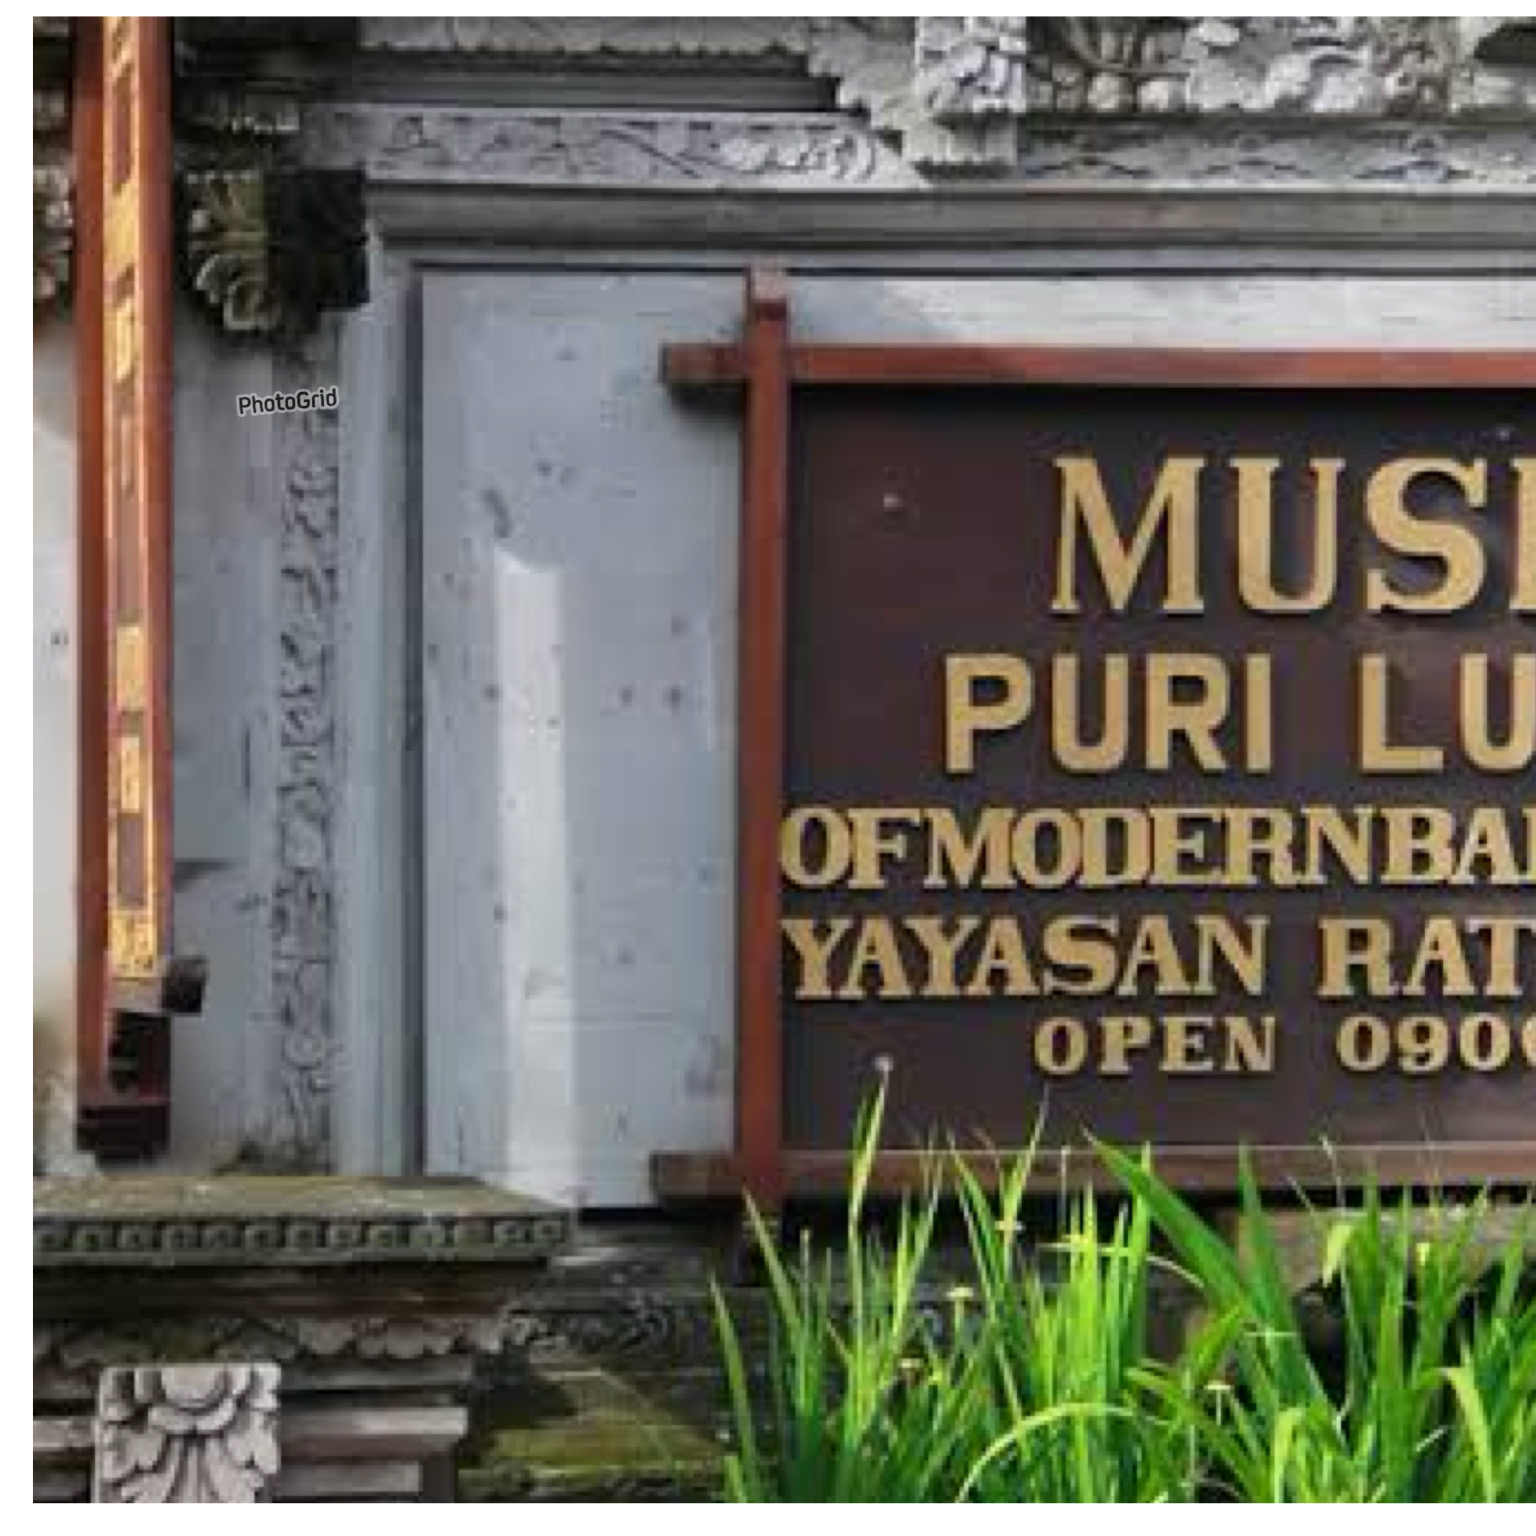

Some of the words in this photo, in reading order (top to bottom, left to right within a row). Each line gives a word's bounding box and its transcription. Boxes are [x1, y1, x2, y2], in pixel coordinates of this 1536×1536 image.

[945, 653, 1273, 774] PURI
[781, 914, 1271, 999] YAYASAN
[1032, 1015, 1275, 1074] OPEN
